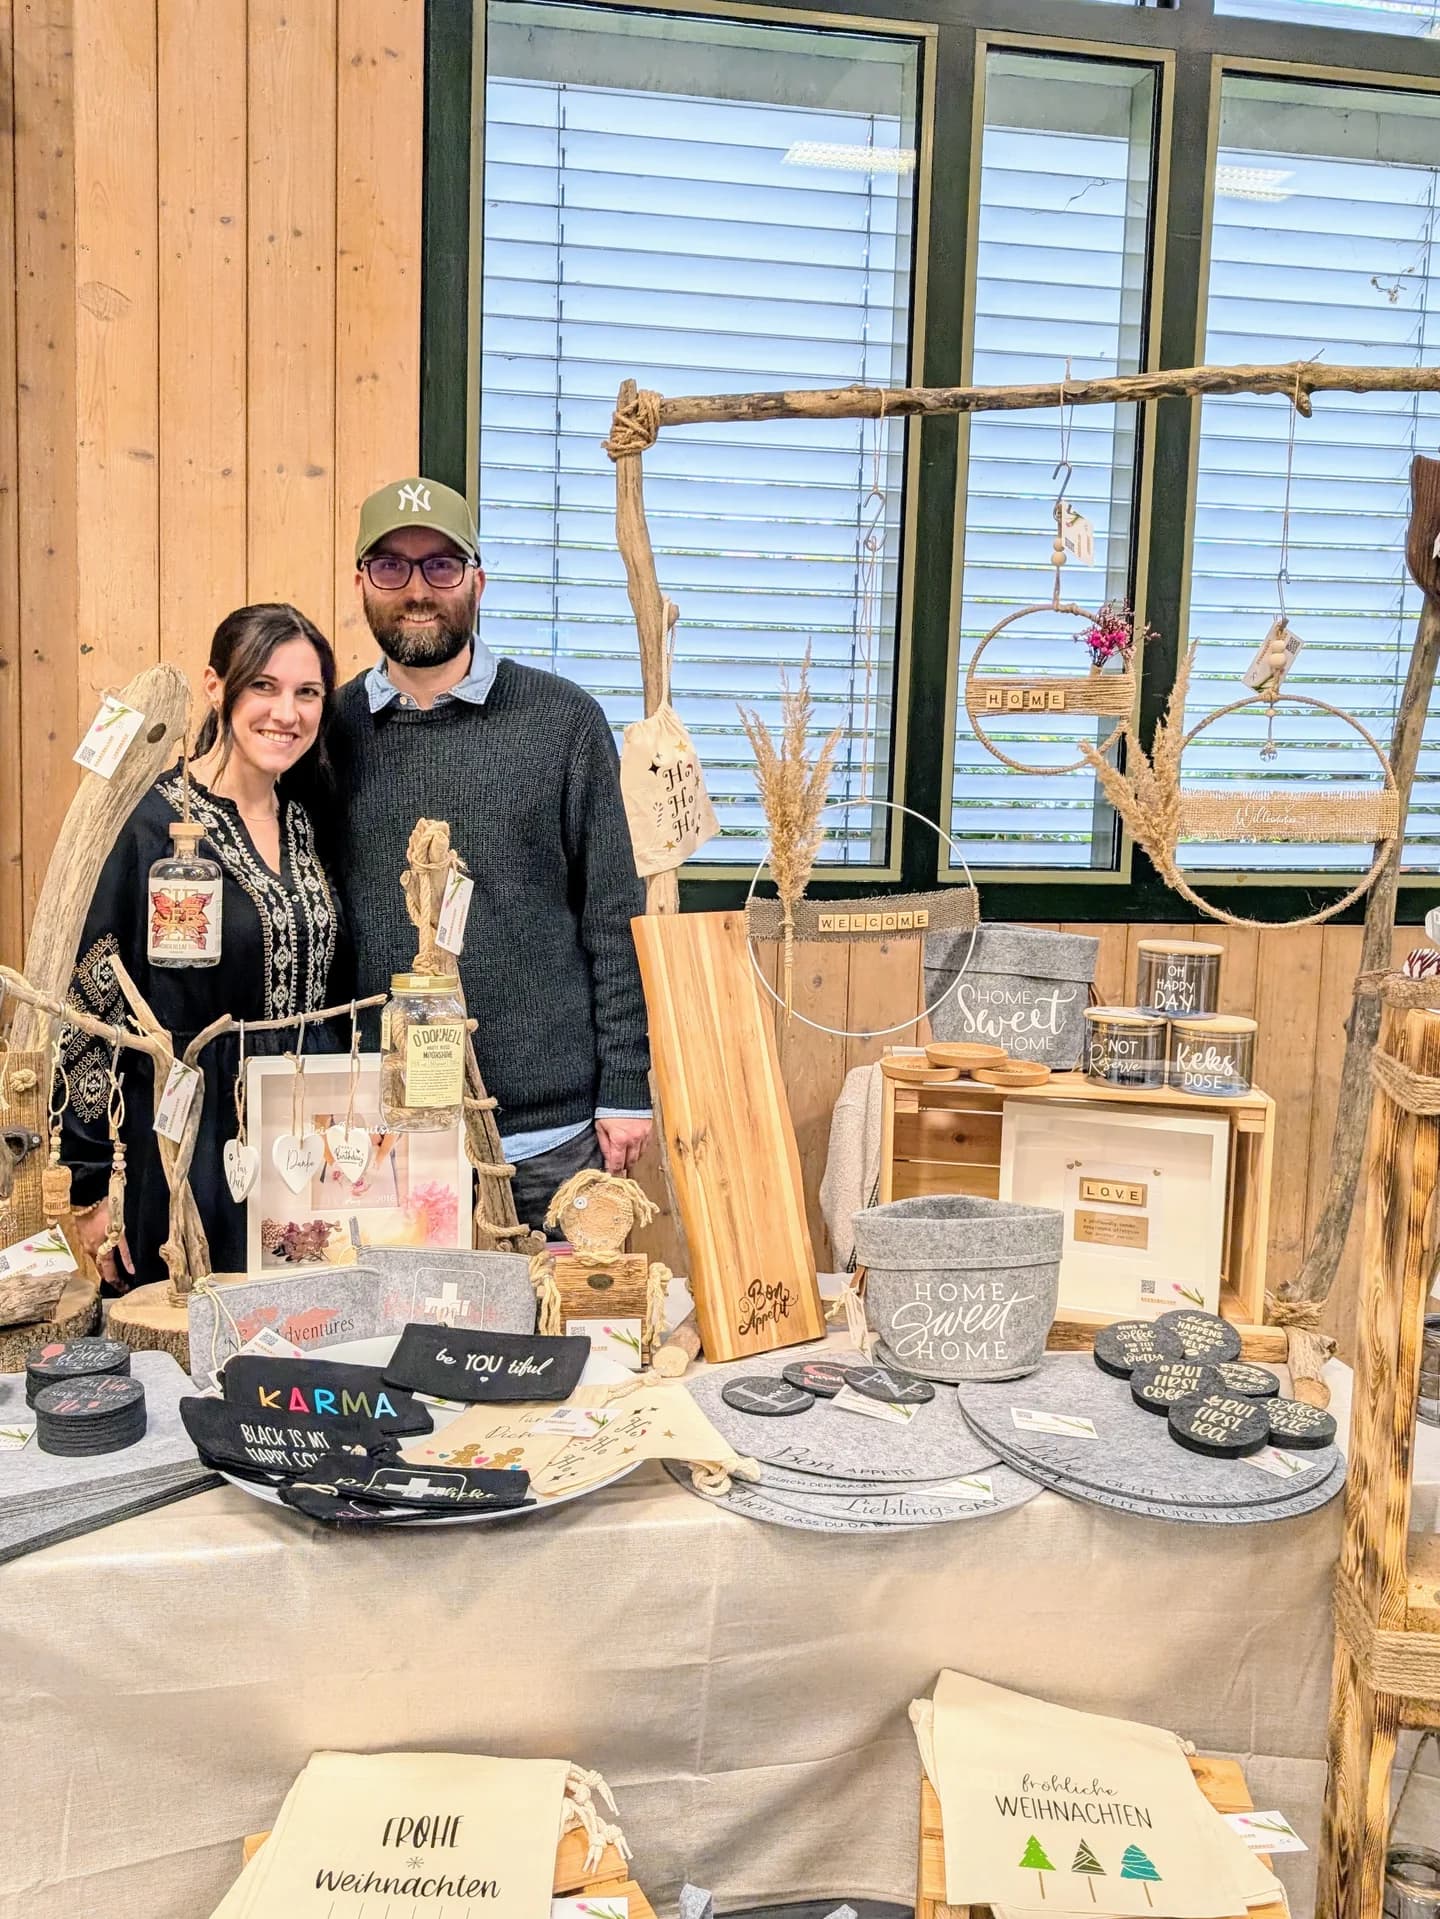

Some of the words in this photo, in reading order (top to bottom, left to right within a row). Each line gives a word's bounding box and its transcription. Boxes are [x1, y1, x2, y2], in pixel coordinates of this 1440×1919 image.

[398, 483, 431, 512] NY
[989, 693, 1062, 705] HOME
[662, 760, 690, 792] Ho
[668, 786, 694, 819] Ho
[820, 914, 926, 929] WELCOME
[1168, 965, 1185, 978] OH
[1156, 978, 1196, 993] HAPPY
[977, 990, 1032, 1005] HOME
[1154, 990, 1194, 1013] DAY
[957, 984, 1077, 1037] Sweet
[1000, 1036, 1055, 1051] HOME
[1108, 1040, 1139, 1055] NOT
[1176, 1042, 1236, 1076] Keks
[1185, 1072, 1224, 1088] DOSE
[1086, 1186, 1140, 1201] LOVE
[914, 1283, 1004, 1302] HOME
[277, 1318, 355, 1347] dventures
[891, 1292, 1034, 1357] Sweet
[1177, 1320, 1223, 1339] HAPPENS
[918, 1341, 1008, 1361] HOME
[436, 1348, 457, 1365] be
[465, 1353, 503, 1374] YOU
[508, 1357, 554, 1378] tiful
[1170, 1364, 1203, 1377] BUT
[258, 1387, 398, 1419] KARMA
[1219, 1399, 1258, 1418] BUT
[240, 1423, 287, 1446] BLACK
[287, 1428, 306, 1448] IS
[307, 1431, 331, 1450] MY
[1190, 1420, 1228, 1442] tea
[244, 1446, 293, 1467] HAPPY
[765, 1446, 835, 1470] Bon
[845, 1468, 916, 1476] APPETIT
[832, 1498, 953, 1518] Lieblings
[1021, 1773, 1118, 1797] fröhliche
[995, 1795, 1153, 1829] WEIHNACHTEN
[383, 1815, 464, 1848] FROHE
[315, 1869, 501, 1899] Weihnachten
